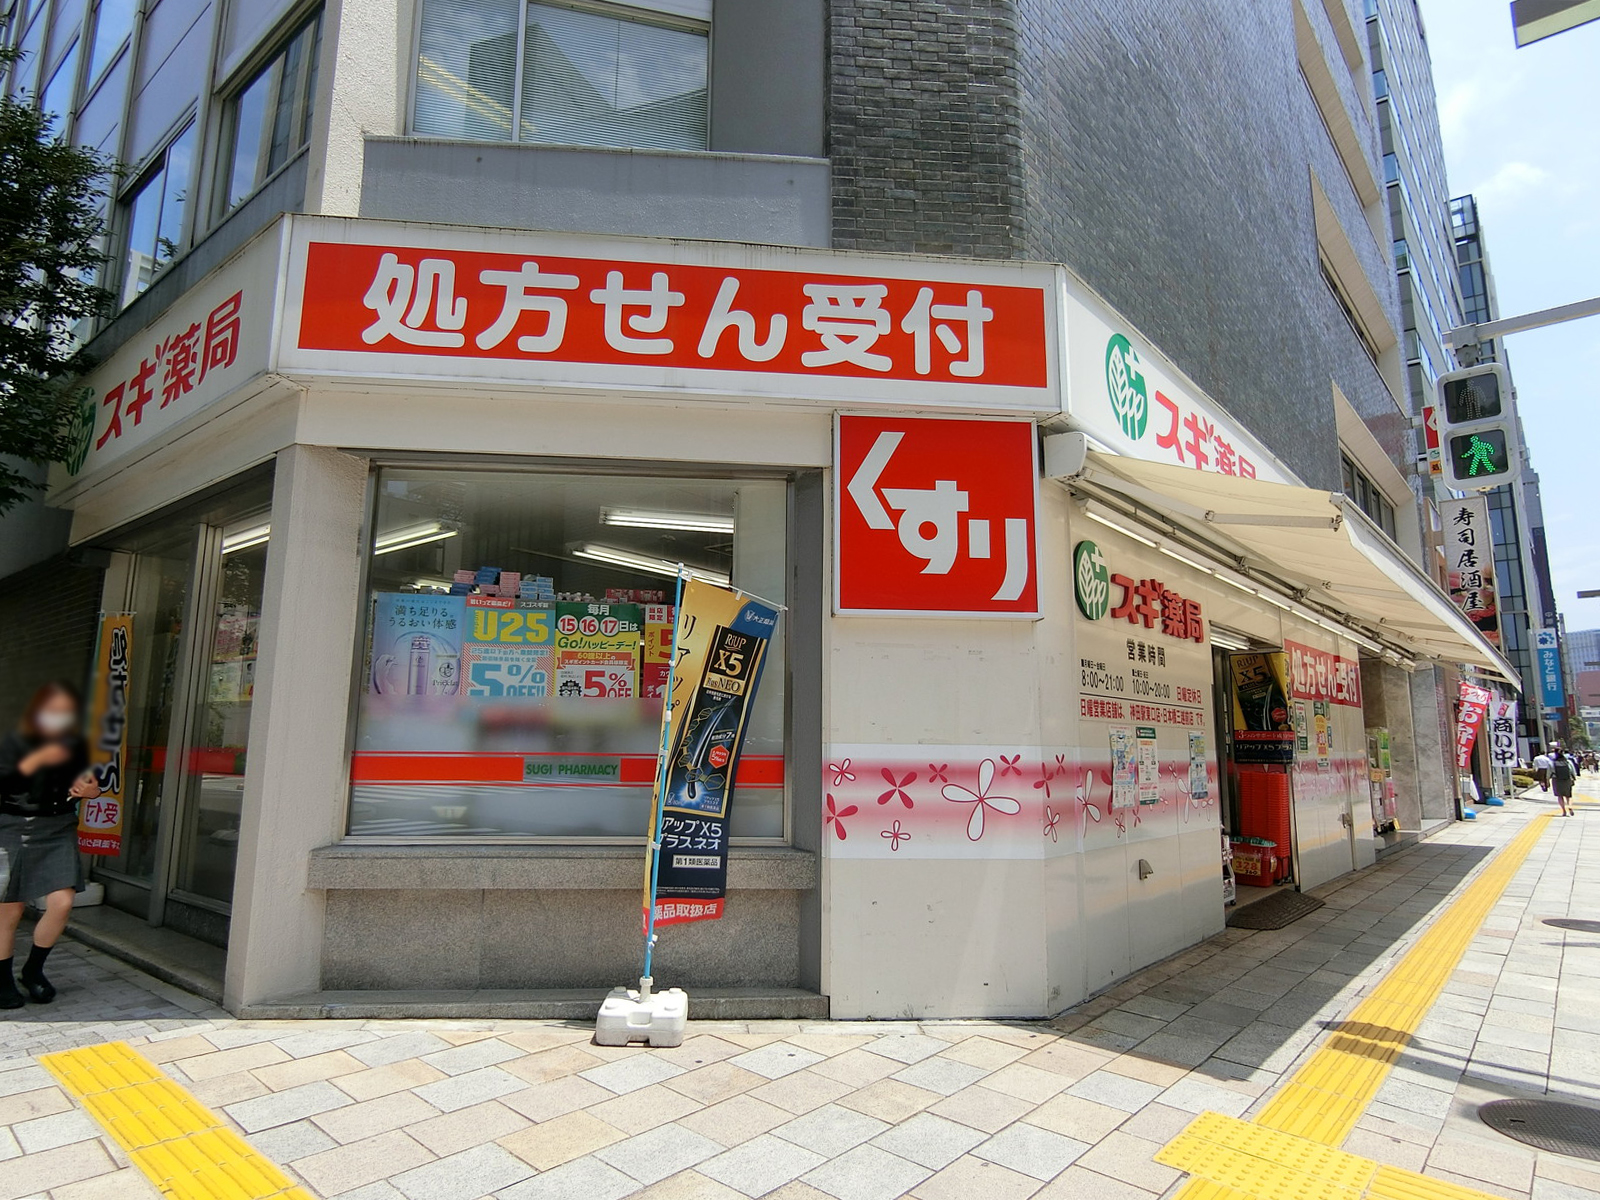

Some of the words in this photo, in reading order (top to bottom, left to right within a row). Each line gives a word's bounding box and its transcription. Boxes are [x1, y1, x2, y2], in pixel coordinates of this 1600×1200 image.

[362, 252, 993, 378] 処方せん受付
[96, 289, 243, 451] スギ薬局
[847, 431, 1027, 601] くすり
[1453, 507, 1485, 612] 寿司居酒屋
[389, 617, 457, 630] うるおい体感
[587, 603, 610, 616] 毎月
[1110, 573, 1204, 643] スギ薬局
[473, 610, 549, 643] U25
[560, 618, 576, 632] 15
[581, 619, 597, 633] 16
[602, 620, 618, 634] 17
[619, 621, 639, 632] 日は
[714, 649, 744, 676] X5
[1126, 638, 1167, 668] 営業時間
[470, 663, 546, 696] 5%
[583, 670, 627, 697] 5%
[1240, 666, 1270, 683] X5
[1292, 647, 1357, 703] 処方せん受付
[1543, 650, 1557, 691] みなと銀行
[1493, 717, 1514, 765] 商い中
[526, 764, 552, 775] SUGI
[558, 764, 618, 775] PHARMACY
[675, 857, 718, 867] 第1類医薬品
